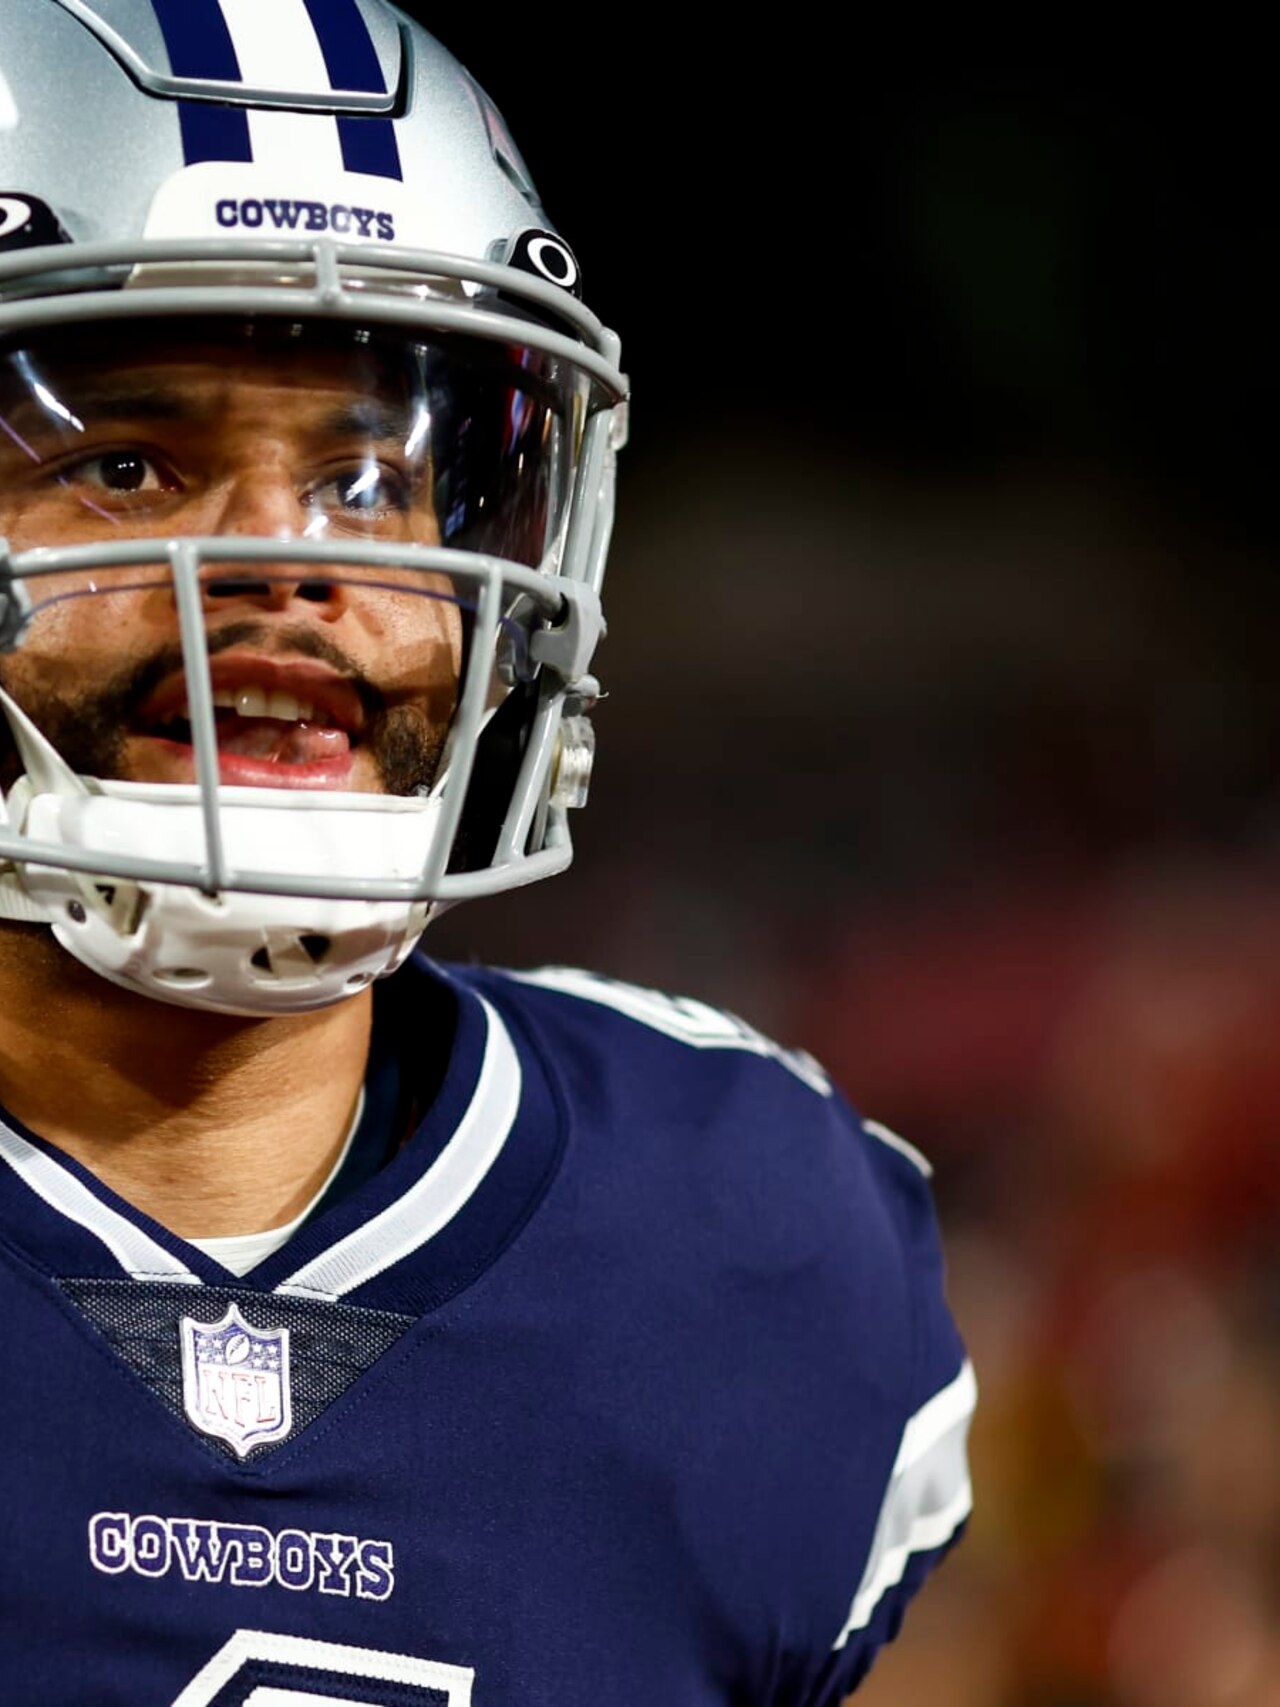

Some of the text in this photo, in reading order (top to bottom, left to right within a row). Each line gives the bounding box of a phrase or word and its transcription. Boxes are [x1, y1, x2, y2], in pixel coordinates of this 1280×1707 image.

[216, 199, 396, 241] COWBOYS
[202, 1369, 277, 1429] NFL
[89, 1511, 395, 1602] COWBOYS
